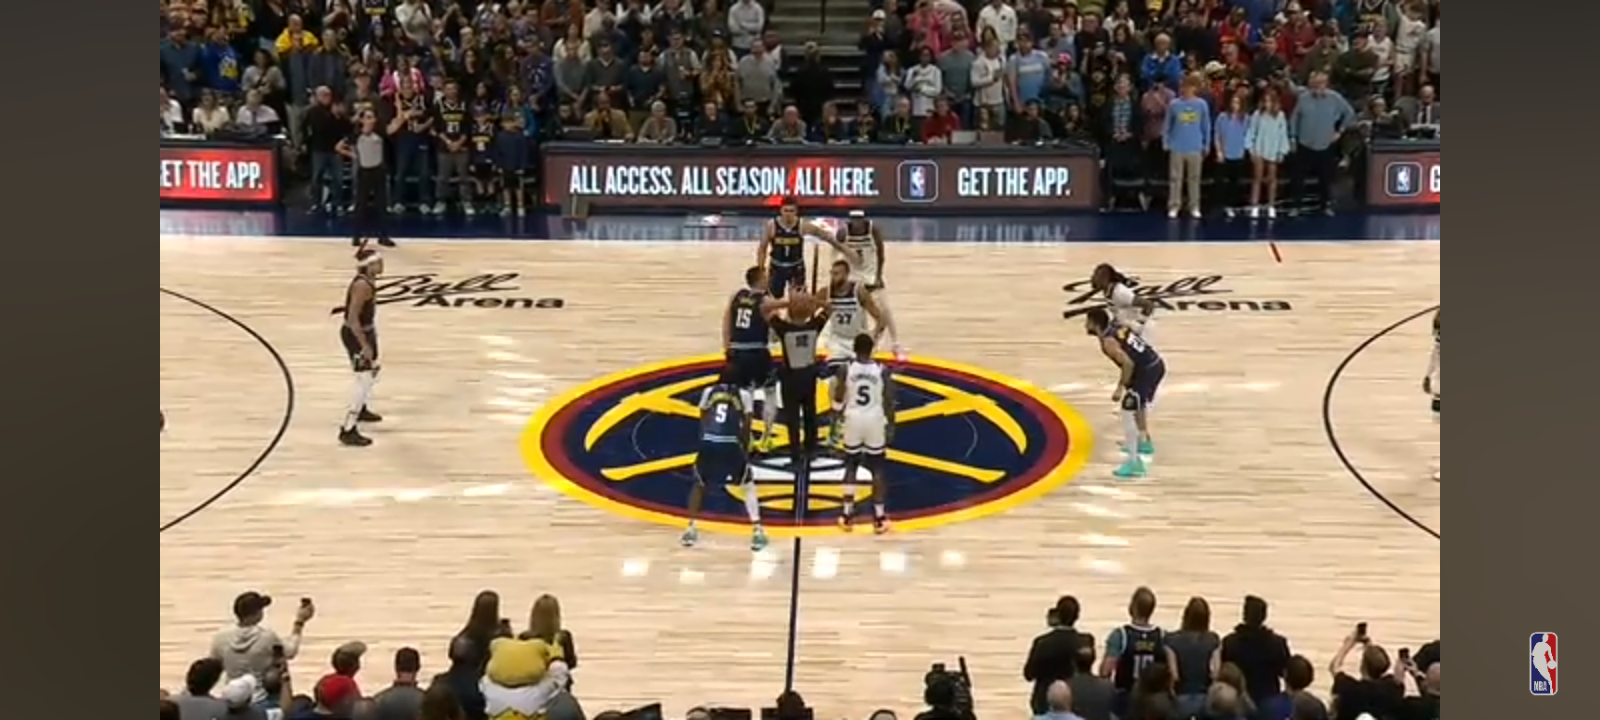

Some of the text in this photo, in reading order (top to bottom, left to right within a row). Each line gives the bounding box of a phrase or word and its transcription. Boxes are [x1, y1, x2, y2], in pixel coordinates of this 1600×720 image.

[160, 160, 264, 189] ET THE APP.
[570, 165, 879, 196] ALL ACCESS. ALL SEASON. ALL HERE.
[957, 167, 1071, 196] GET THE APP.
[413, 296, 564, 309] Arena
[735, 308, 753, 329] 15
[855, 385, 871, 406] 5
[714, 403, 729, 423] 5
